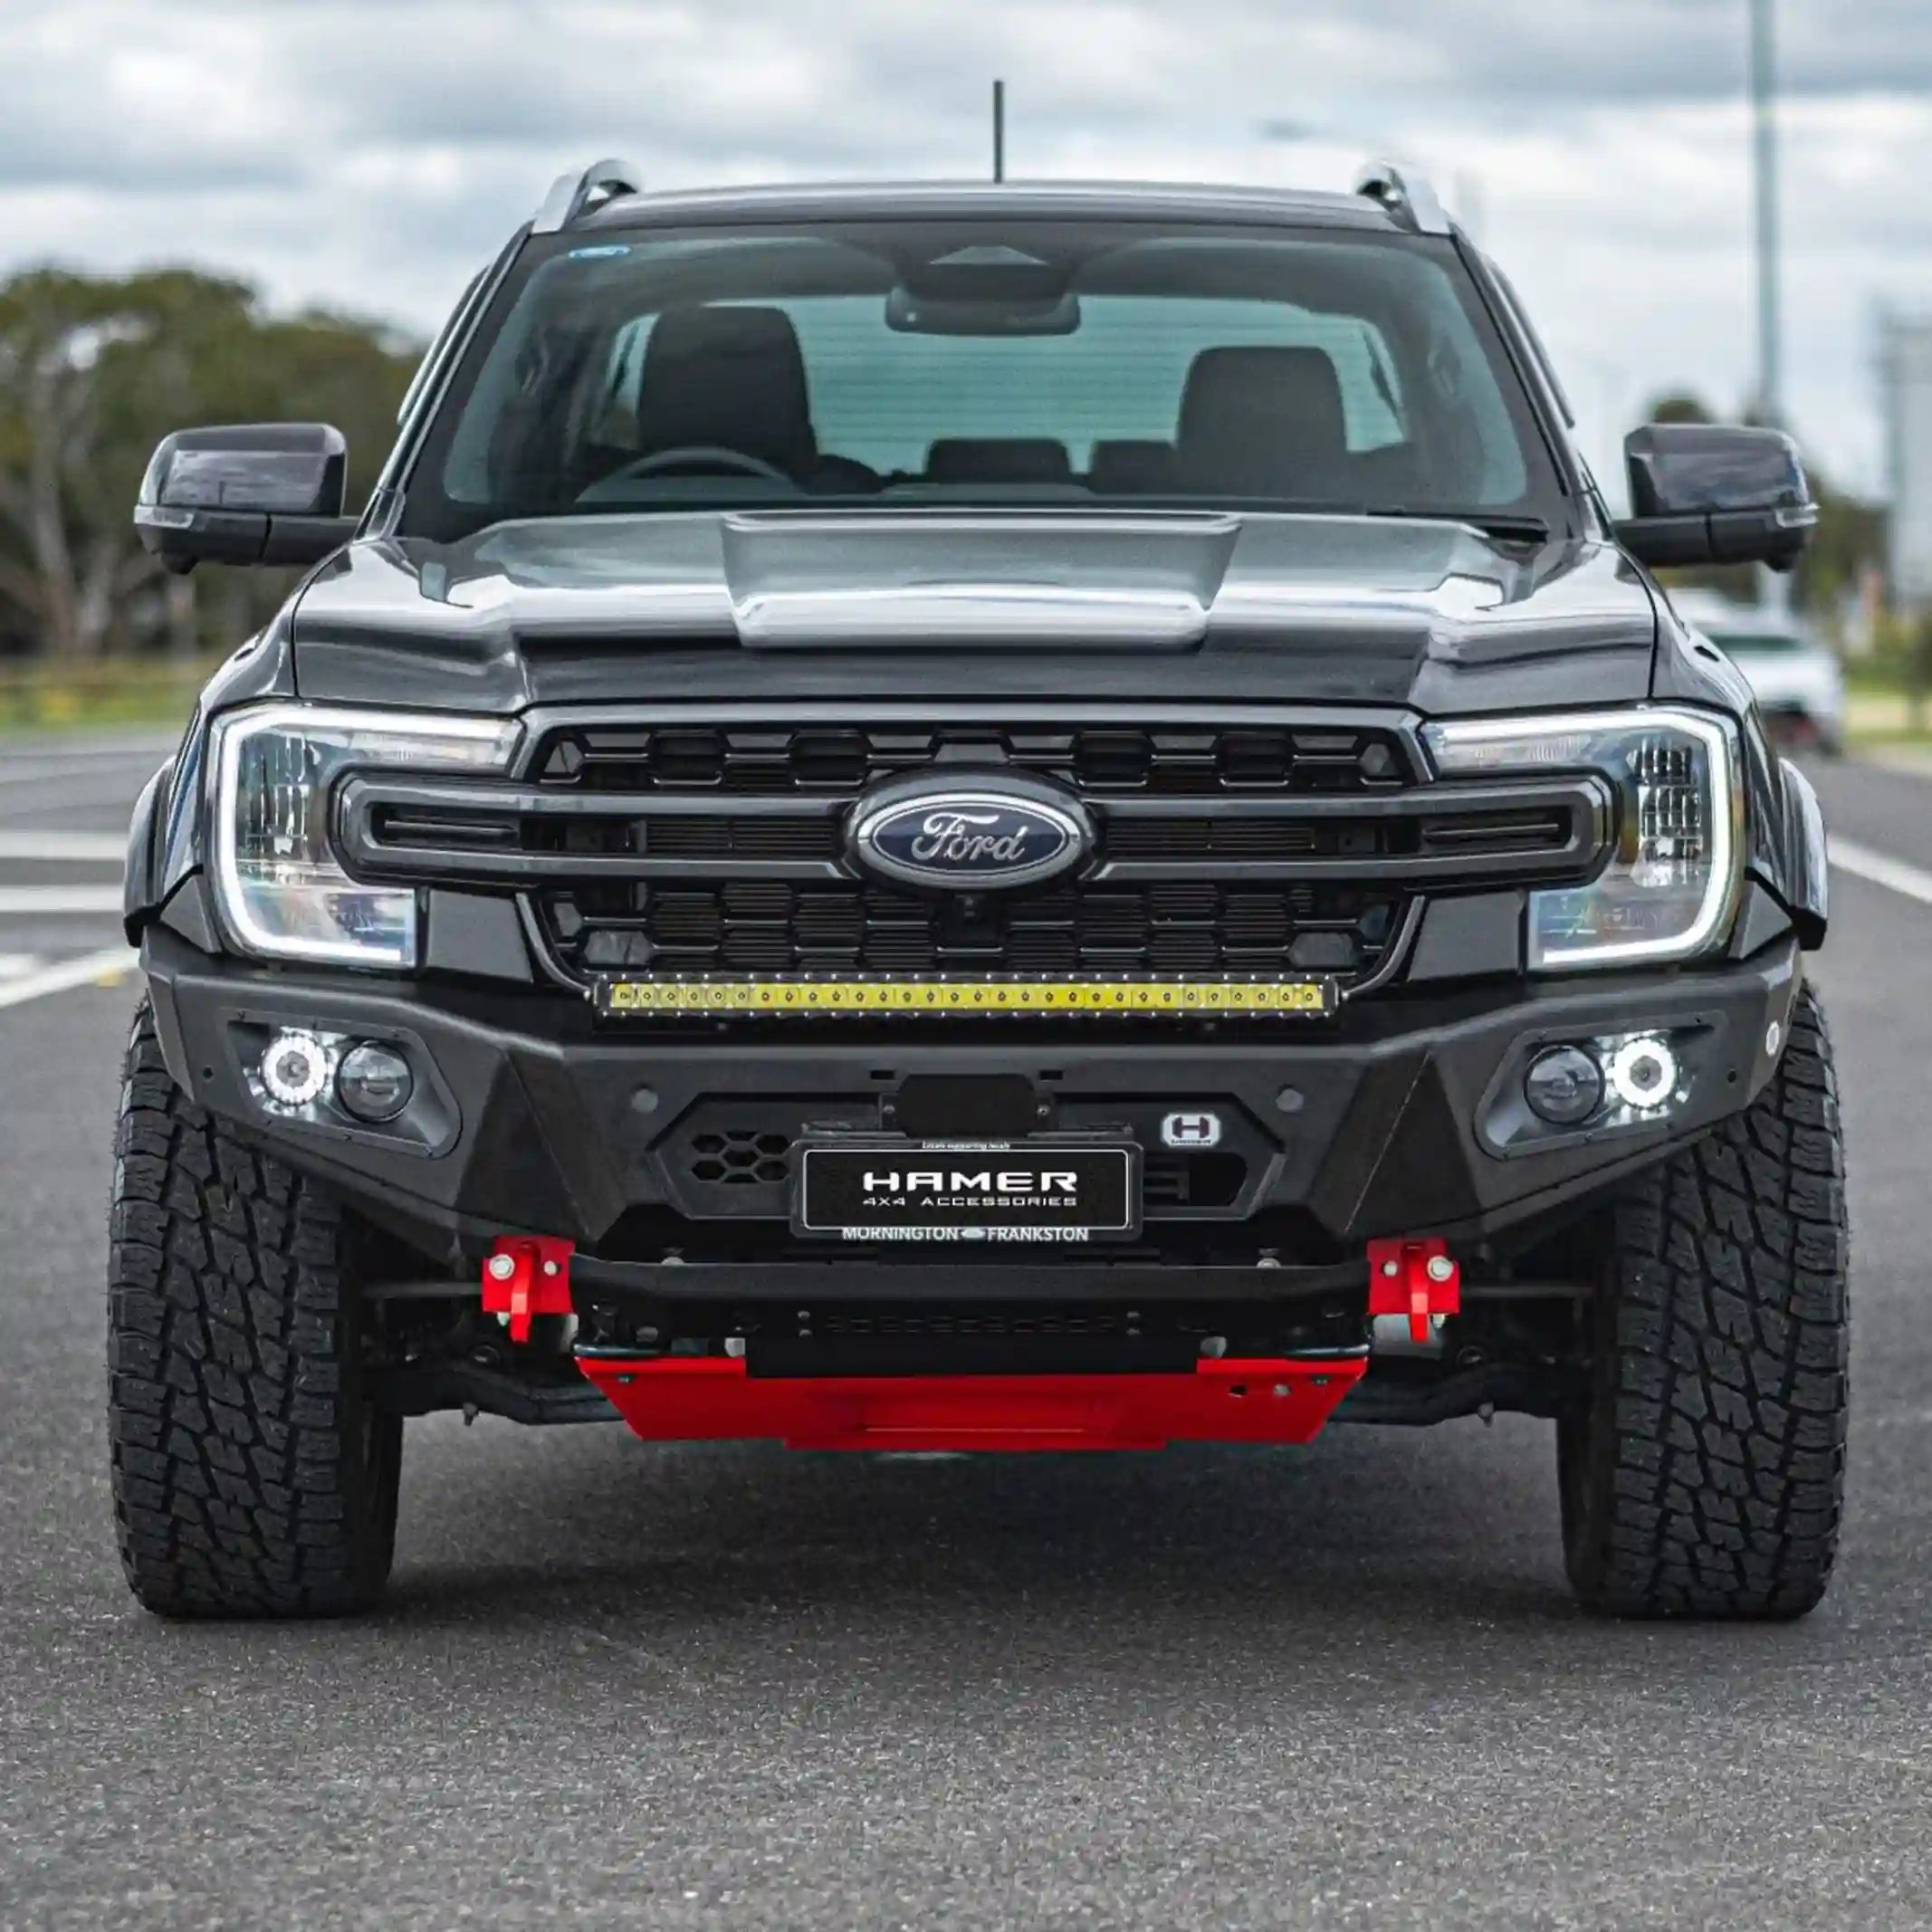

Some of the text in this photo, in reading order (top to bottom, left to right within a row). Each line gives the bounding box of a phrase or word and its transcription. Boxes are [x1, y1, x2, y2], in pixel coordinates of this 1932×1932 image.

[911, 812, 1028, 860] Ford
[863, 1172, 1077, 1191] HAMER
[862, 1196, 1077, 1207] 4X4 ACCESSORIES
[842, 1228, 1088, 1241] MORNINGTON FRANKSTON
